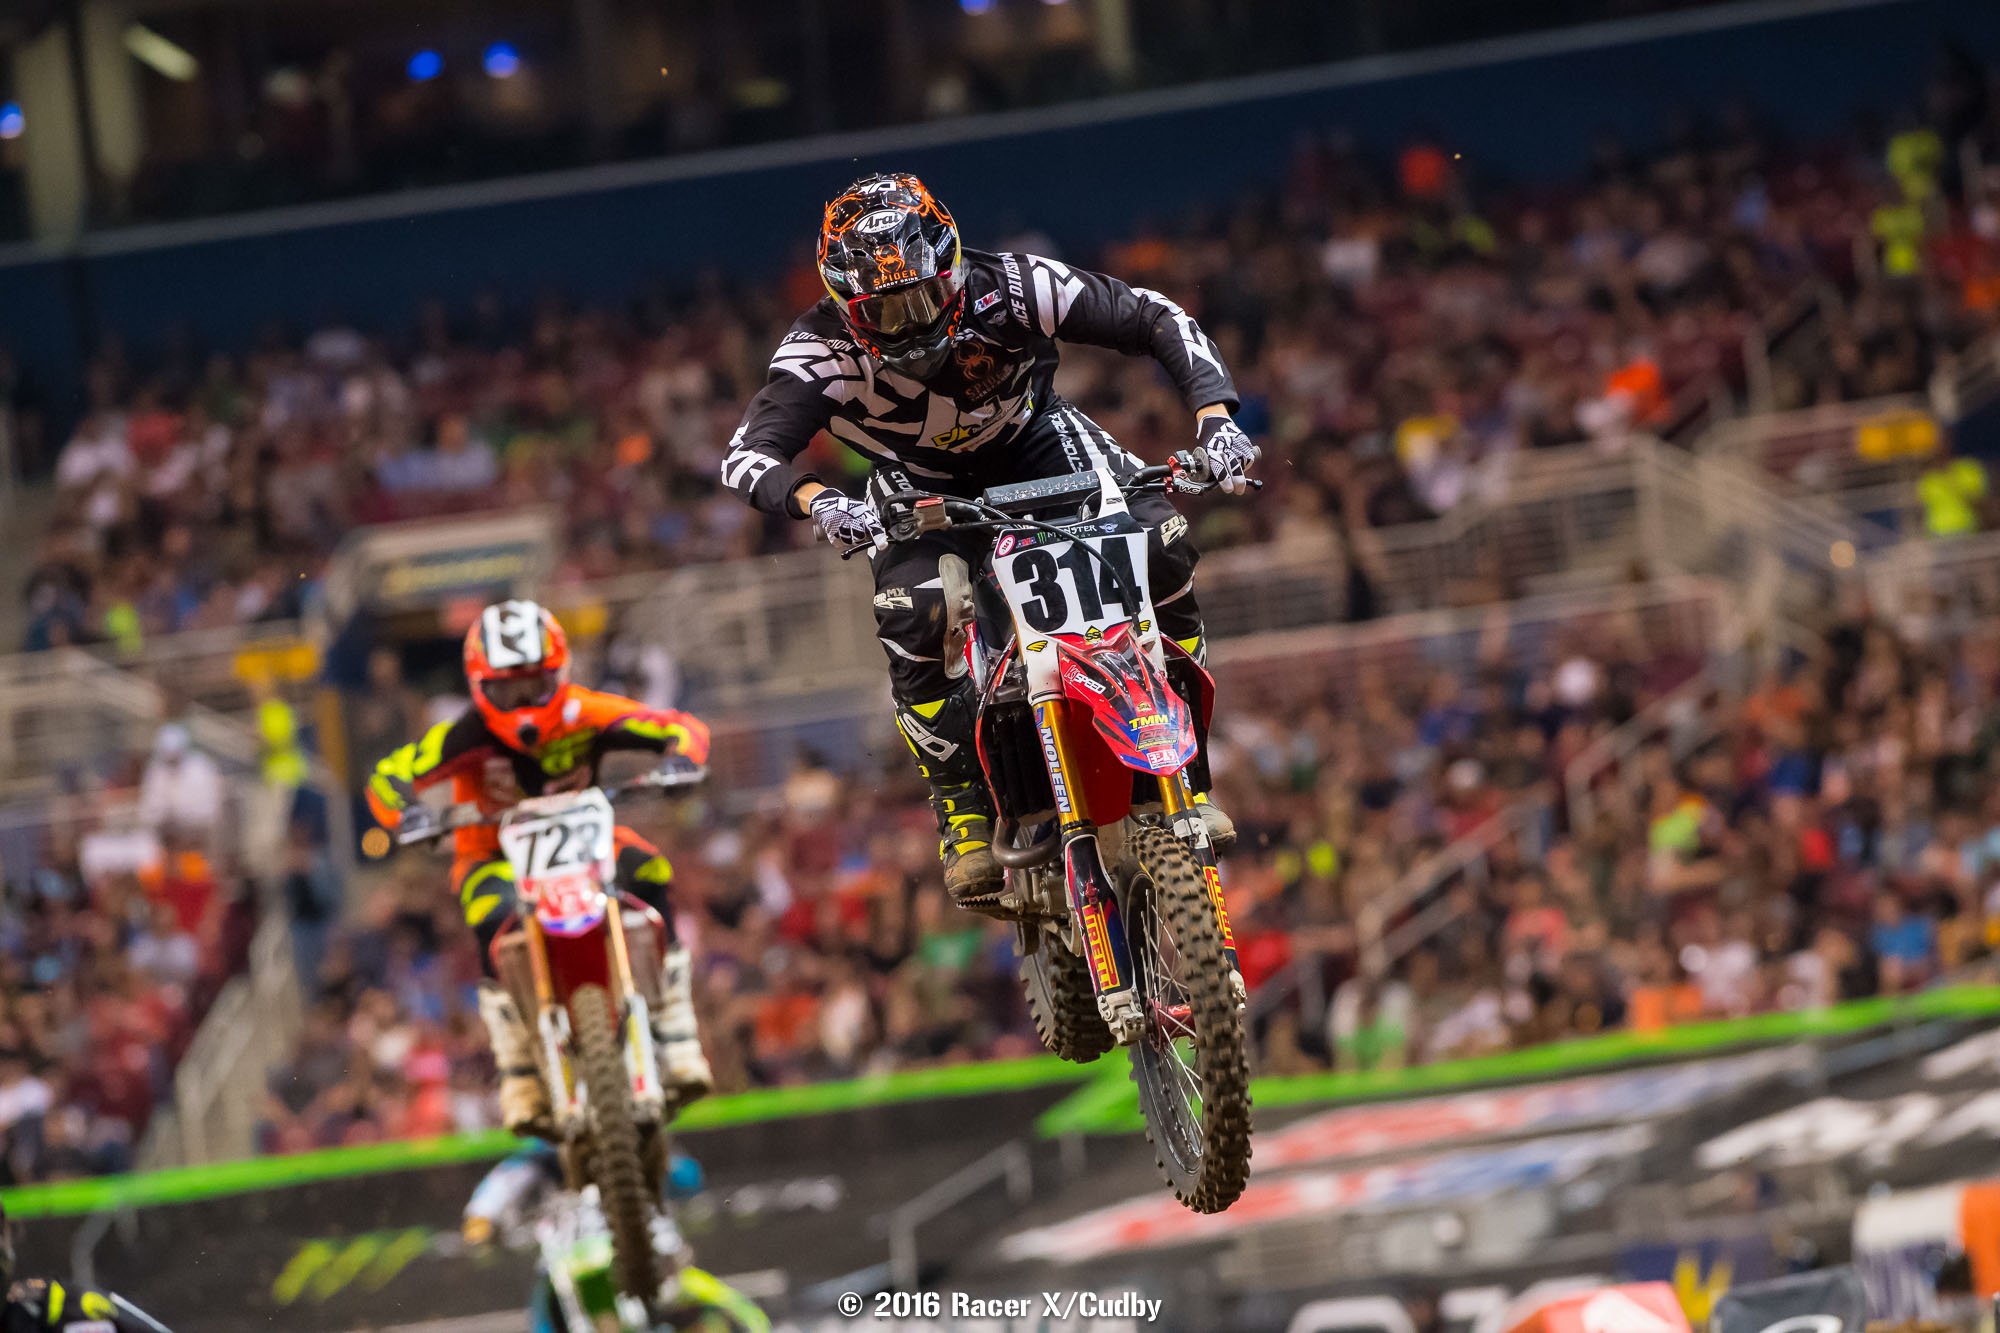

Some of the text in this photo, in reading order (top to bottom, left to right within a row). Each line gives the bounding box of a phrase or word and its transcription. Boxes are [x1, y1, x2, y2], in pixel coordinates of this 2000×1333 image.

[864, 213, 903, 229] Arai
[873, 269, 917, 286] SPIDER
[795, 331, 855, 352] DIVSION
[1047, 524, 1097, 538] MNSTER
[1012, 536, 1143, 633] 314
[1129, 714, 1168, 729] TMM
[1040, 726, 1072, 813] NOLEEN
[1082, 903, 1119, 990] PIRELLI
